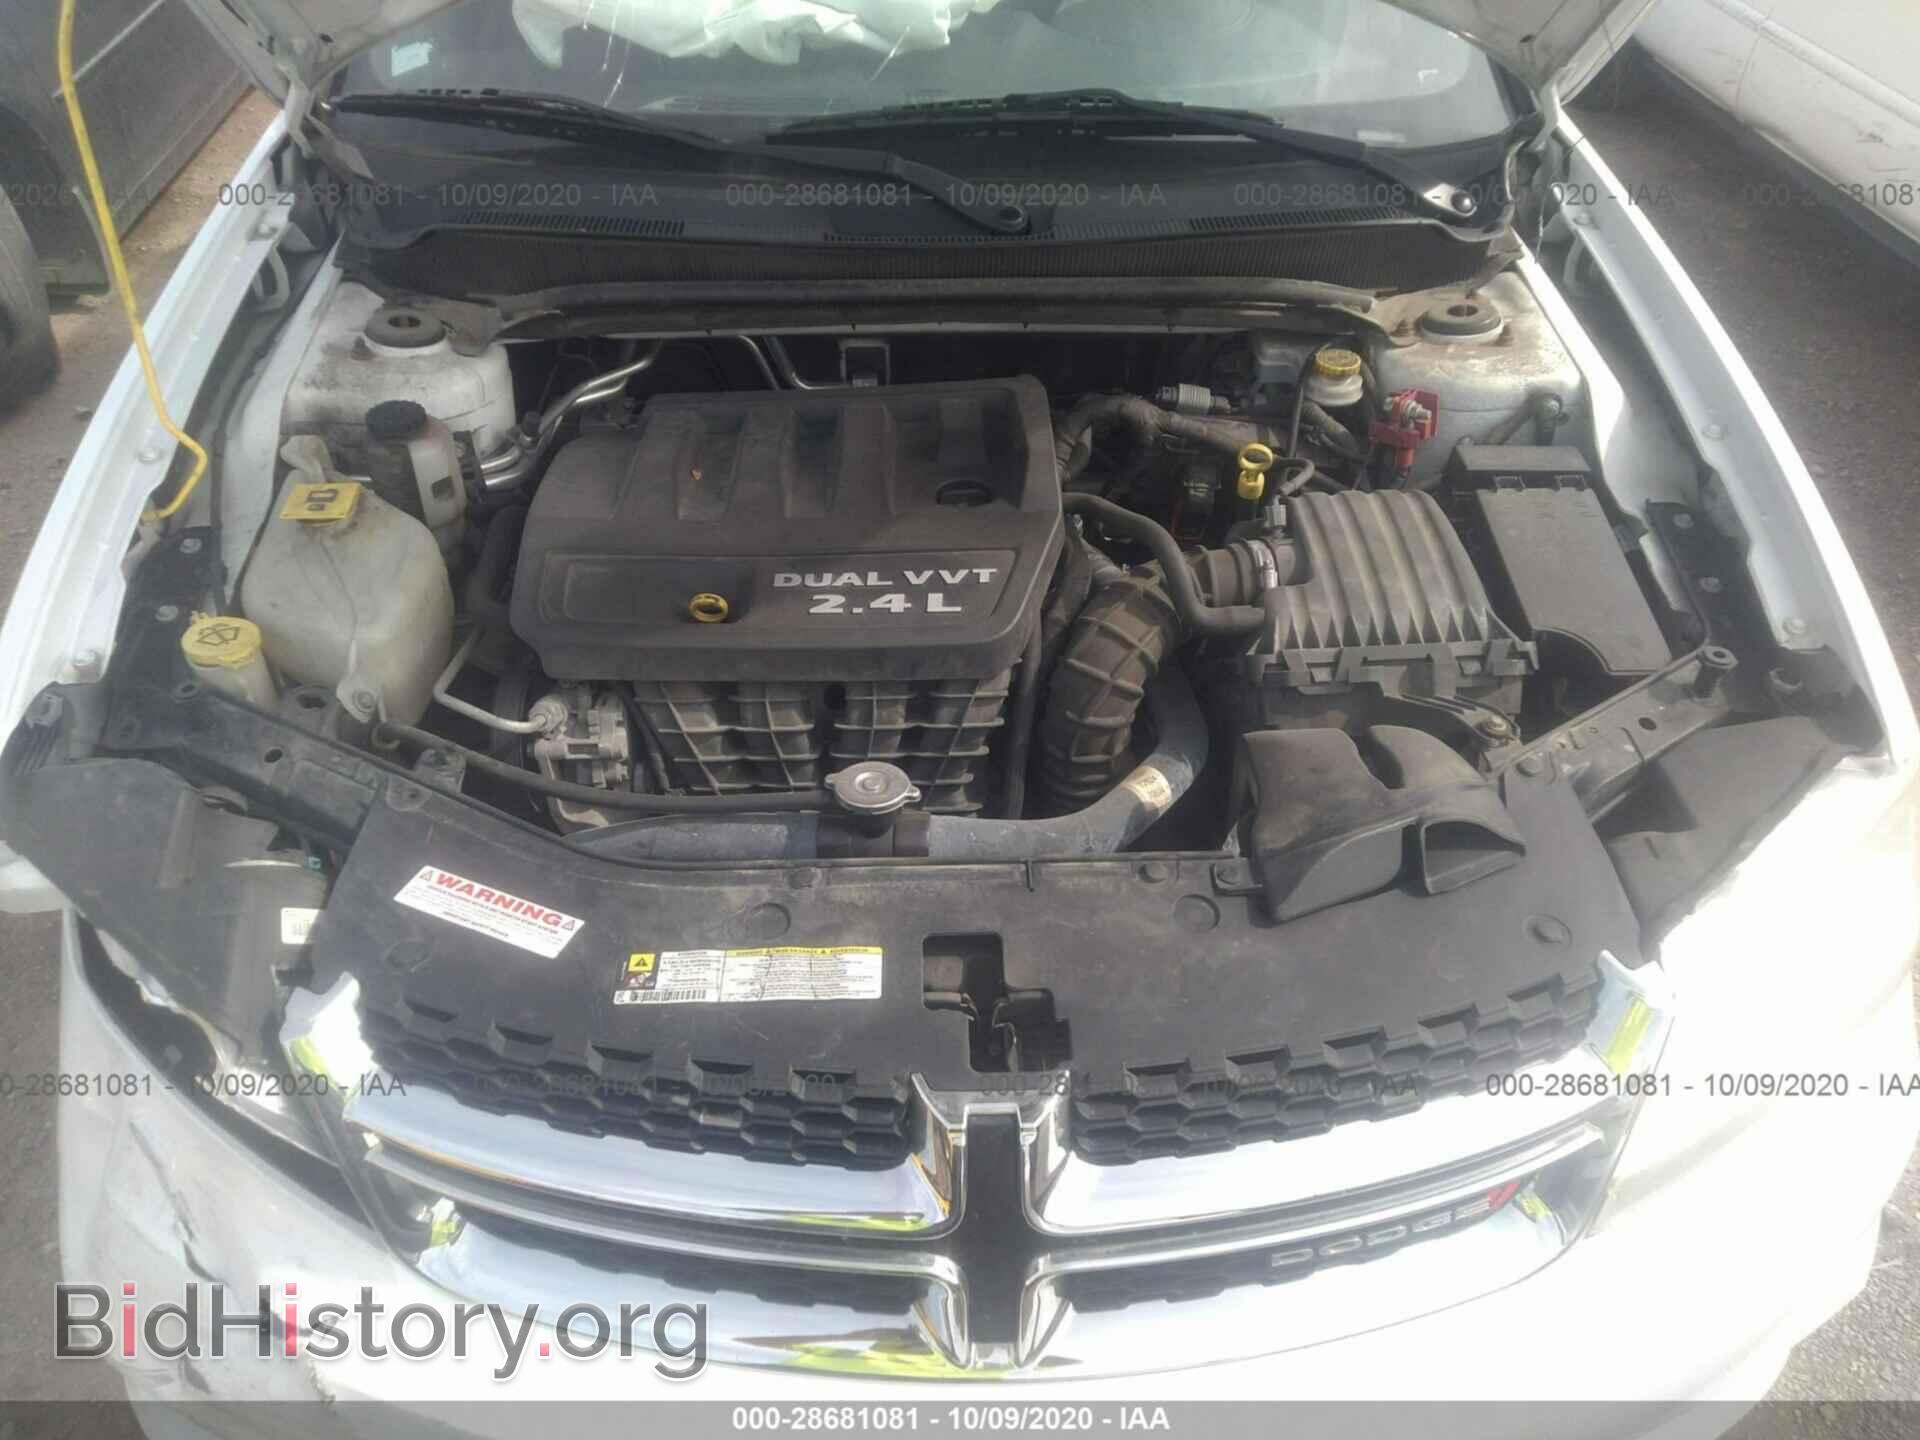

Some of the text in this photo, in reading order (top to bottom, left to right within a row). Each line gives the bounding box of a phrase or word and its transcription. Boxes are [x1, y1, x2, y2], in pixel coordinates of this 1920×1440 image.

[773, 568, 997, 587] DUAL VVT
[435, 872, 564, 928] WARNING
[1270, 1197, 1491, 1267] DODGE
